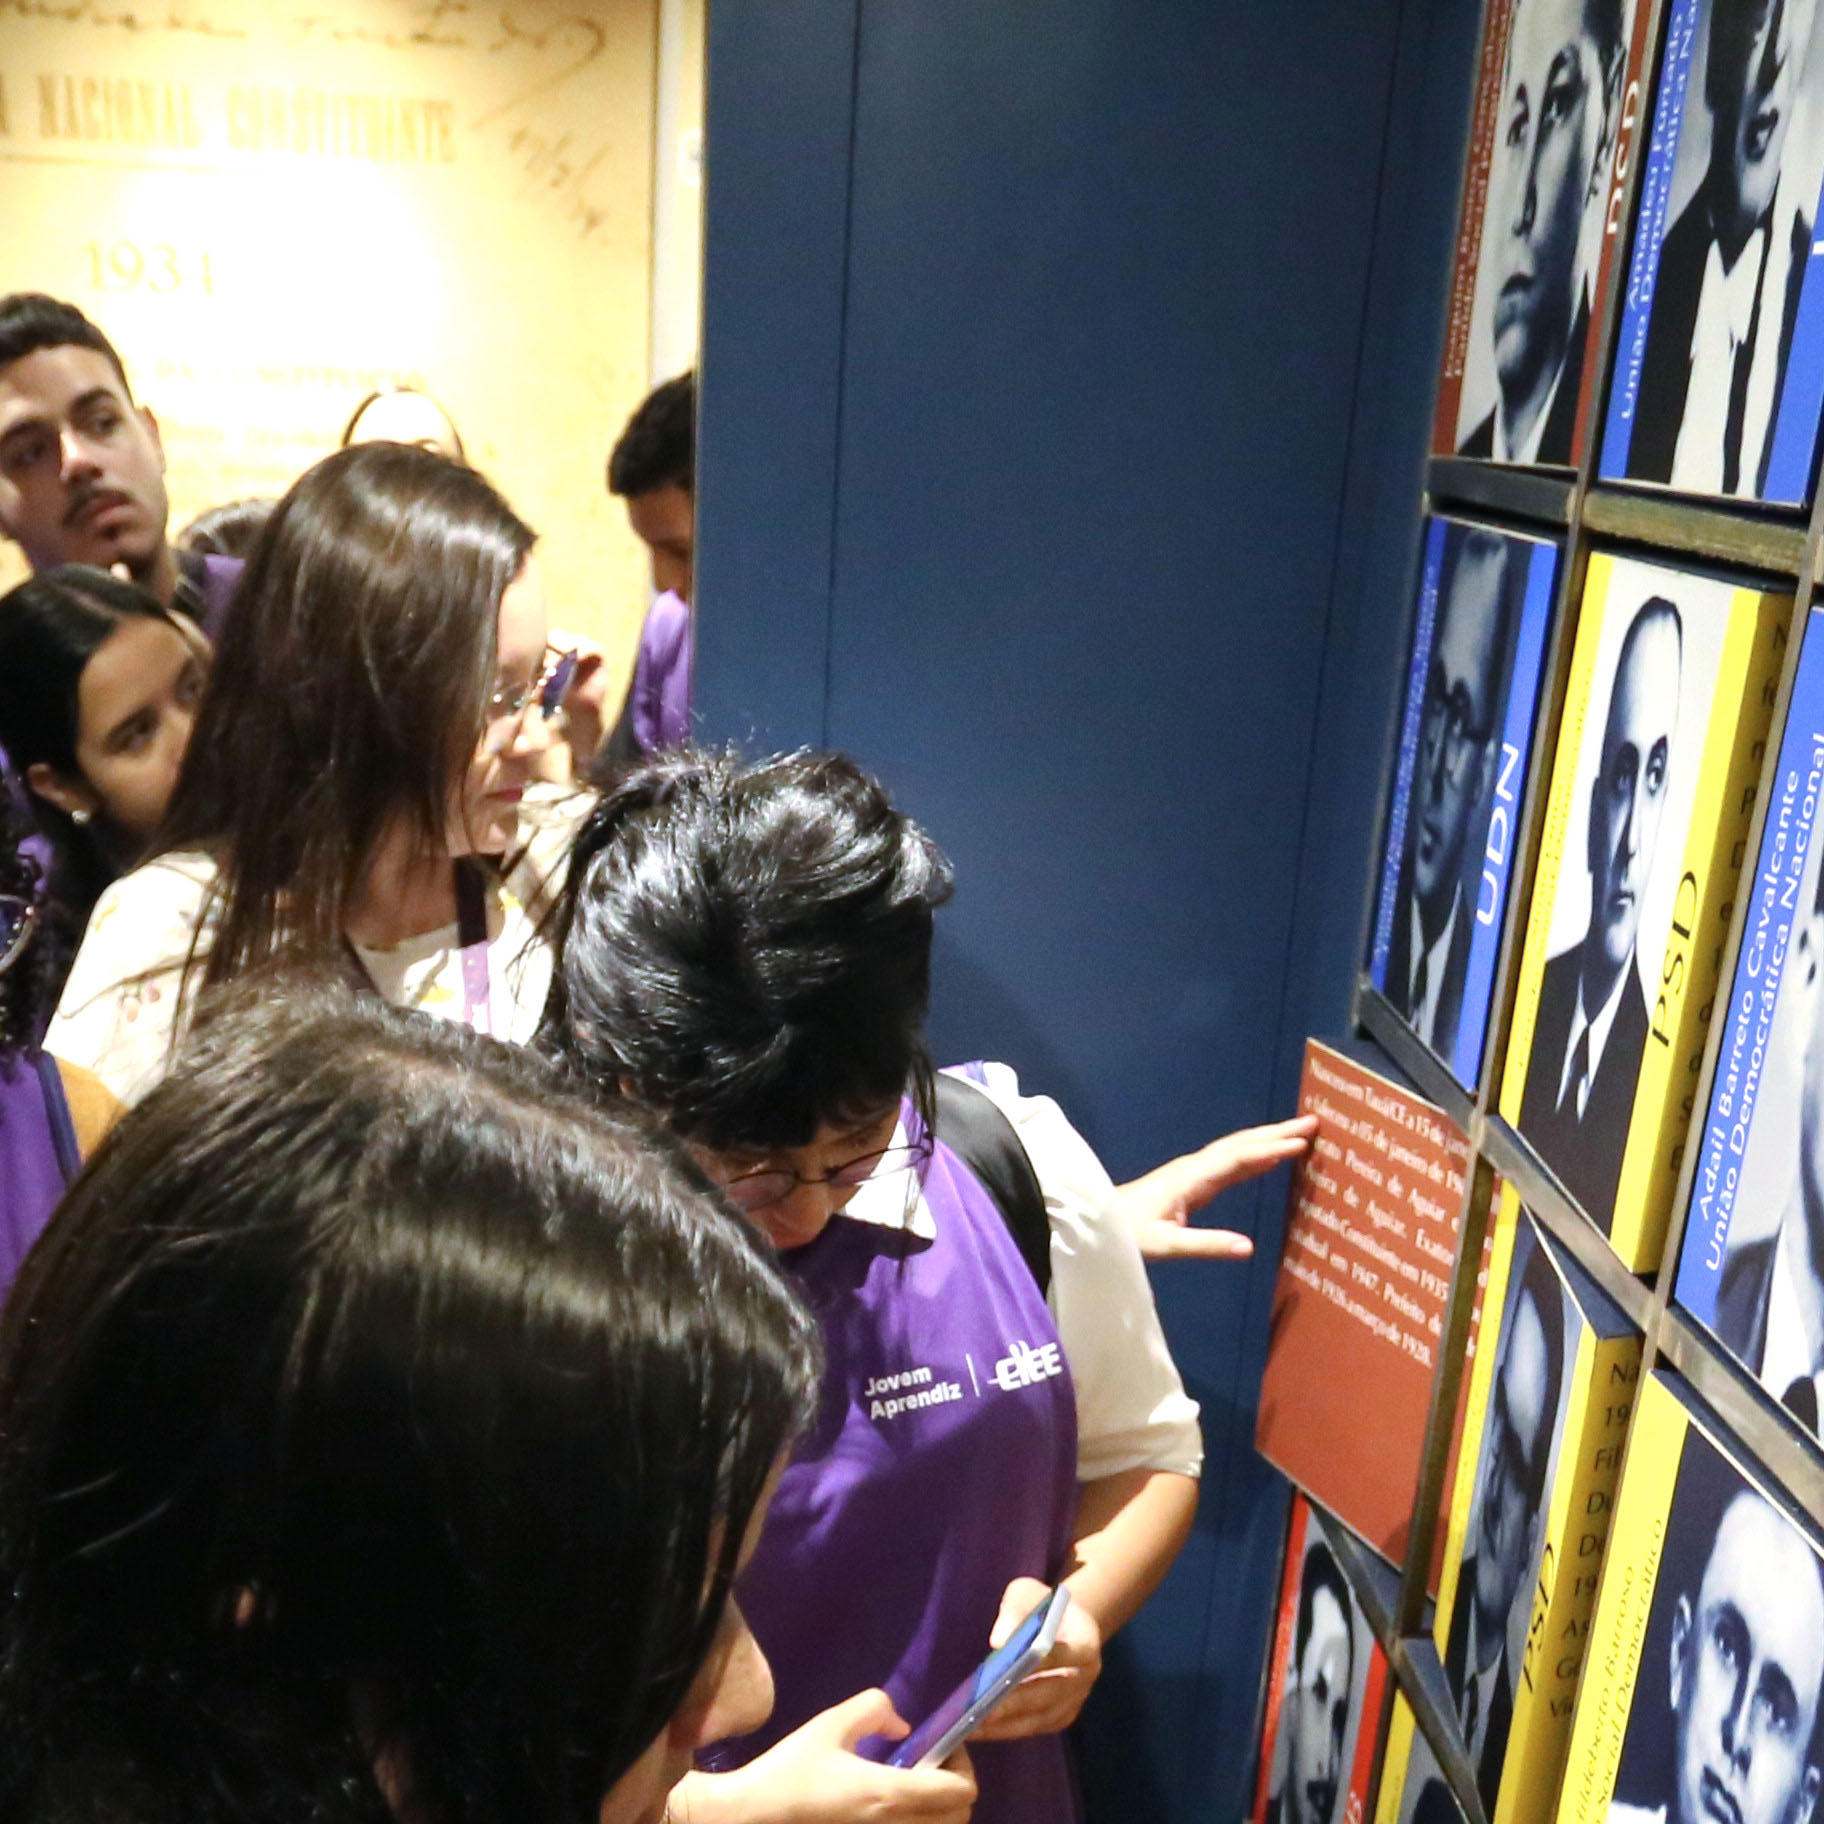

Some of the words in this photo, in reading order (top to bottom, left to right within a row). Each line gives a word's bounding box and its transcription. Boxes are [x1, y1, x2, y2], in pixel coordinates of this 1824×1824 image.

[34, 73, 204, 150] NACIONAL
[224, 83, 461, 166] CONSTITUINTE
[1476, 741, 1521, 927] UDN
[1650, 870, 1698, 1049] PSD
[1696, 1125, 1726, 1223] Adail
[1716, 991, 1757, 1120] Barreto
[1746, 769, 1801, 972] Cavalcante
[1705, 1175, 1737, 1274] União
[1729, 909, 1788, 1168] Democrática
[864, 1364, 932, 1398] Jovem
[870, 1381, 962, 1421] Aprendiz
[1522, 1540, 1555, 1694] PSD
[1597, 1718, 1623, 1806] Social
[1616, 1518, 1663, 1717] Democrático
[1603, 1564, 1634, 1676] Barroso
